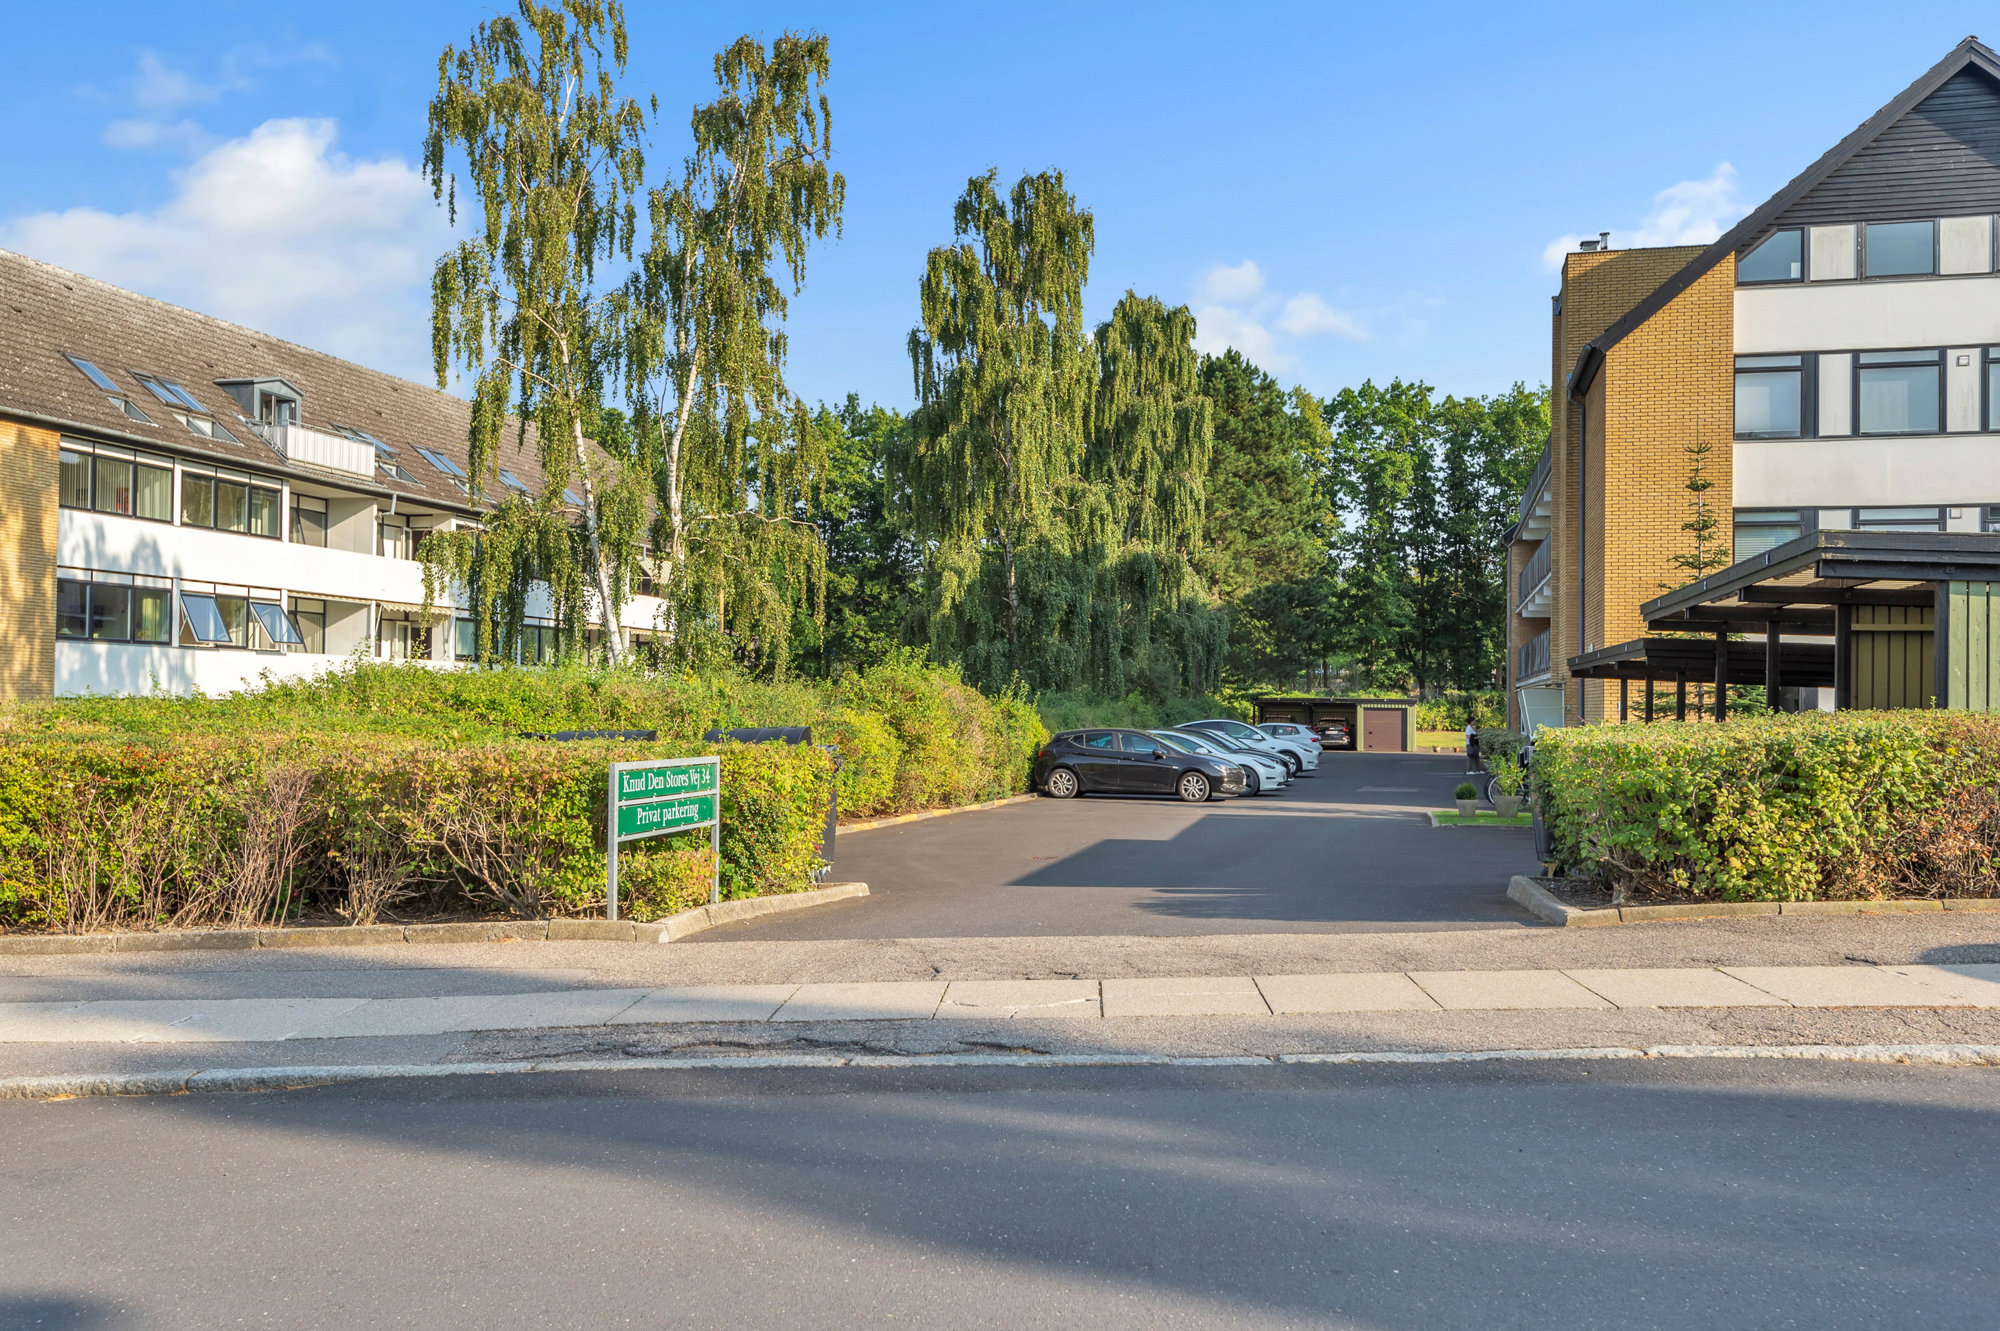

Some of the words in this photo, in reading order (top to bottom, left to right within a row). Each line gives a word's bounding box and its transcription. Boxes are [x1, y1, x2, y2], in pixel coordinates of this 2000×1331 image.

[623, 772, 645, 792] Knud
[648, 773, 664, 790] Den
[666, 771, 688, 788] Stores
[689, 768, 700, 789] Vej
[702, 768, 711, 784] 34
[637, 807, 661, 825] Privat
[663, 801, 699, 826] parkering
